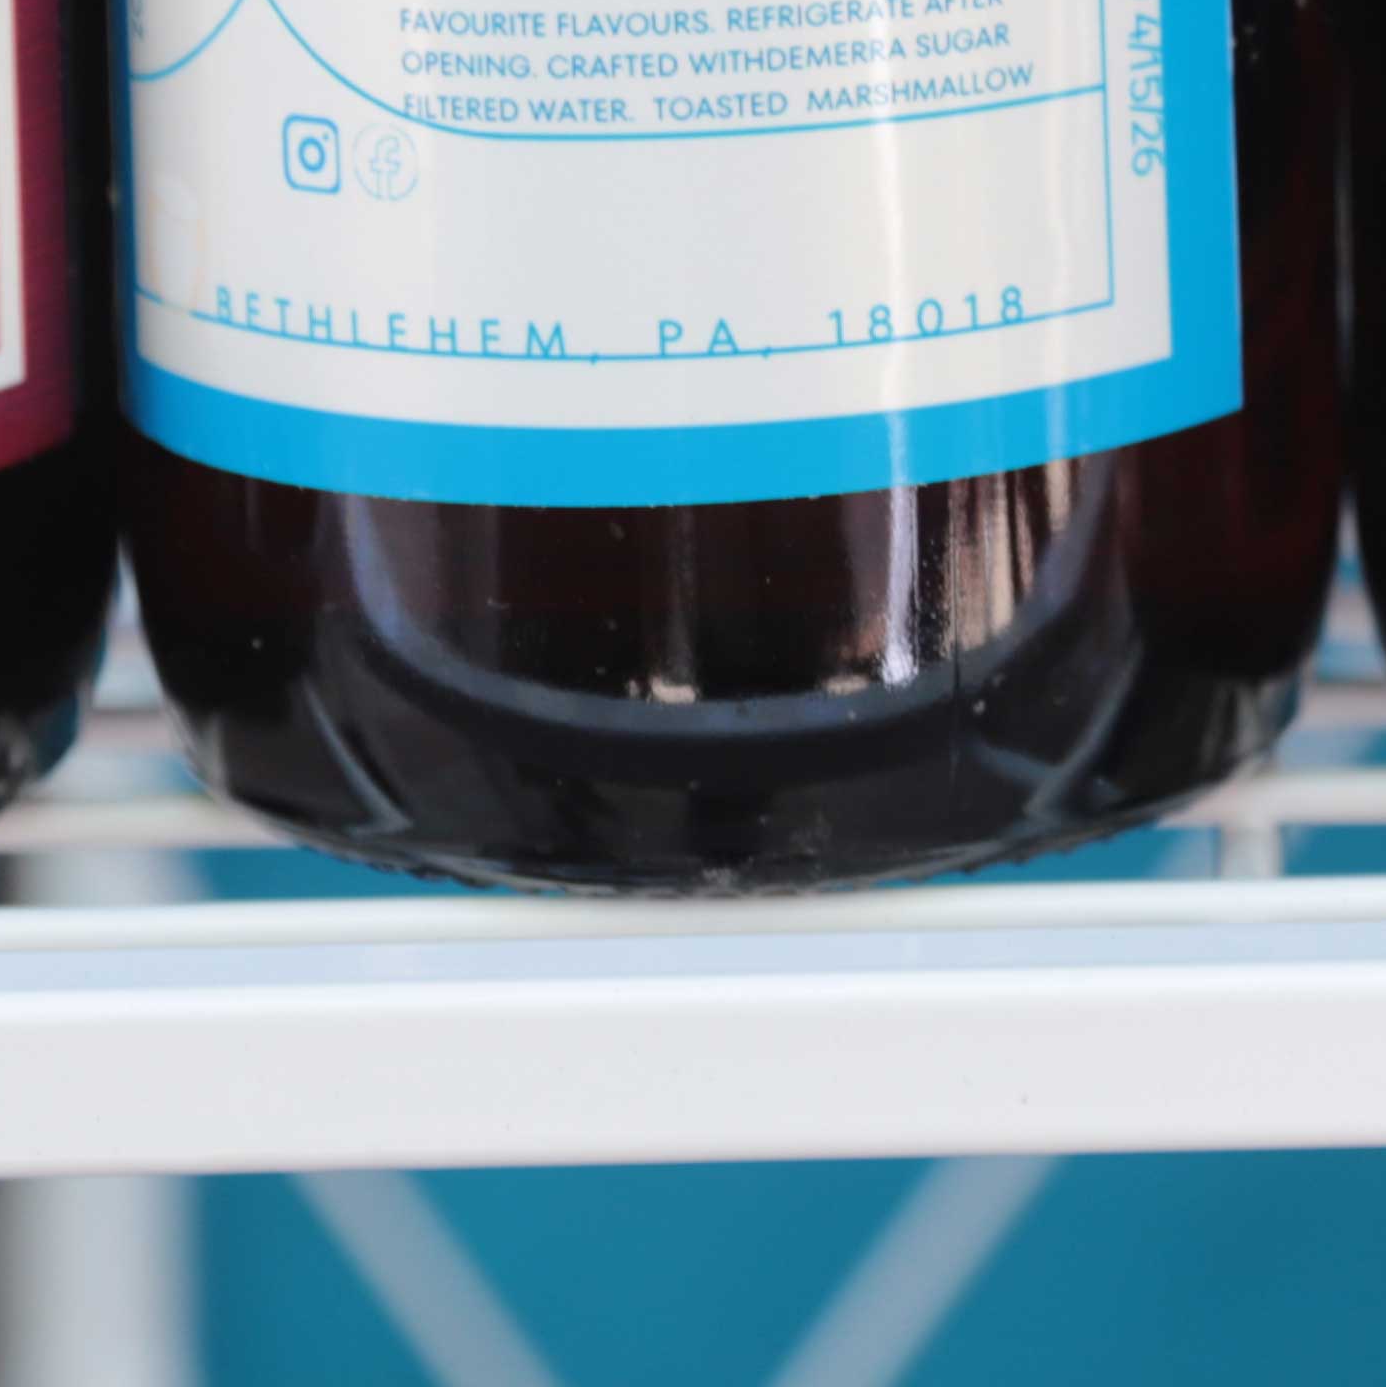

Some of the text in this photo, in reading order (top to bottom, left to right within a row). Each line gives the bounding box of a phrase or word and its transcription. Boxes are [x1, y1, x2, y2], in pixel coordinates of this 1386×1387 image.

[400, 8, 545, 38] FAVOURITE
[546, 51, 678, 80] CRAFTED
[916, 22, 1010, 58] SUGAR
[403, 93, 519, 123] FILTERED
[653, 91, 788, 121] TOASTED
[806, 62, 1034, 112] MARSHMALLOW
[1126, 13, 1165, 177] 4/15/26
[829, 285, 1024, 347] 18018
